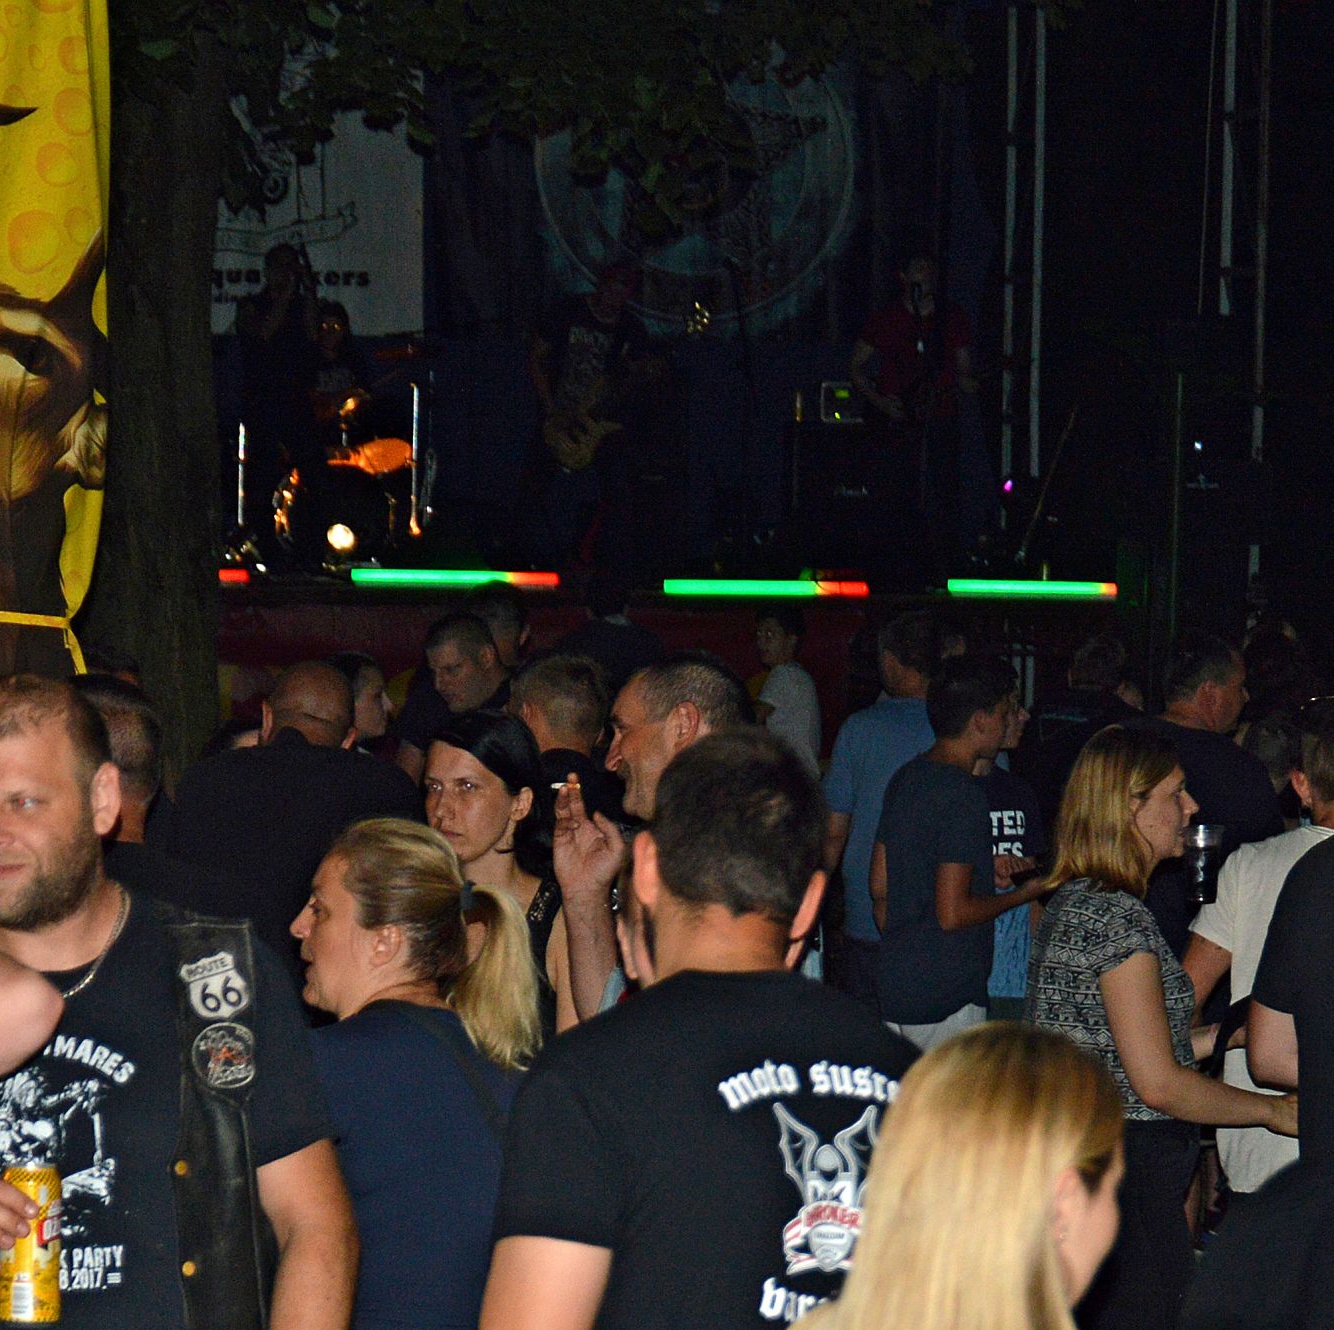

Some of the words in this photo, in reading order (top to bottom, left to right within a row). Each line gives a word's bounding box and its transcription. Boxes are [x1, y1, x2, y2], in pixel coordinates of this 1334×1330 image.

[186, 956, 229, 977] ROUTE
[201, 976, 242, 1012] 66
[44, 1034, 136, 1084] MARES
[72, 1245, 124, 1269] PARTY
